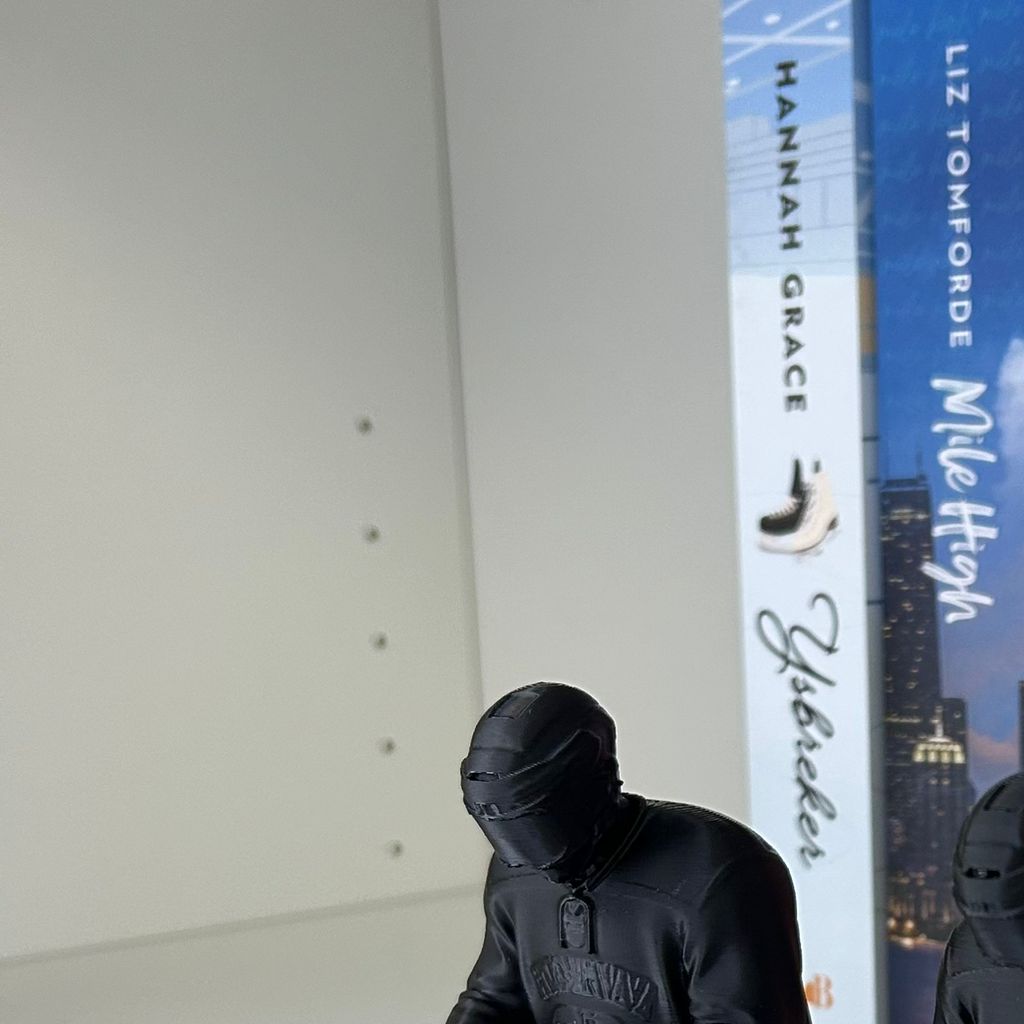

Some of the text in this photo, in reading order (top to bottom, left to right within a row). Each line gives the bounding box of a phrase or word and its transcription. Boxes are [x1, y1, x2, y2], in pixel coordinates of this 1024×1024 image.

[775, 60, 808, 413] HANNAH GRACE
[945, 44, 973, 348] LIZ TOMFORDE
[921, 376, 998, 625] Mile High
